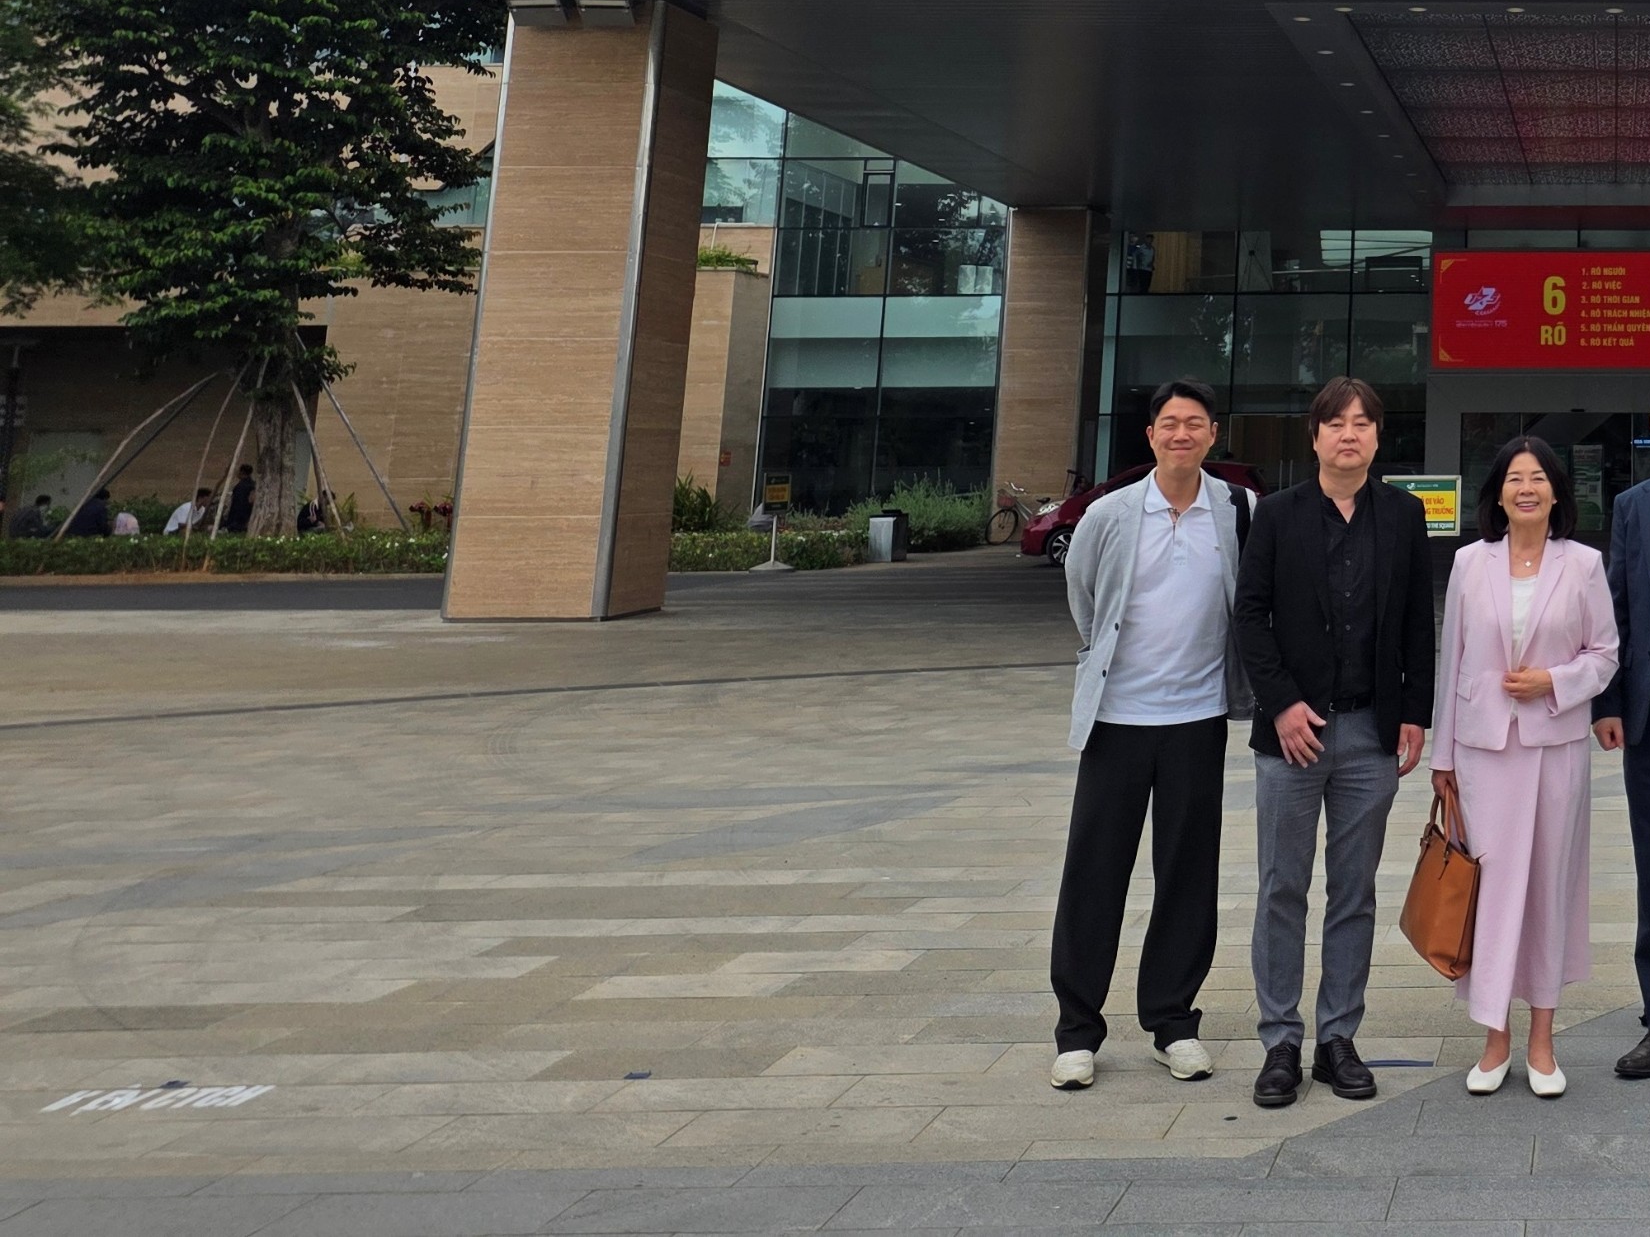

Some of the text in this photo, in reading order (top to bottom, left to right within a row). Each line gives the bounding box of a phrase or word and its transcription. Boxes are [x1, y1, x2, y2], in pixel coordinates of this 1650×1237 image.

[1543, 275, 1566, 315] 6
[1622, 295, 1640, 304] GIAN
[1603, 308, 1628, 318] TRÁCH
[1540, 321, 1566, 346] RÕ
